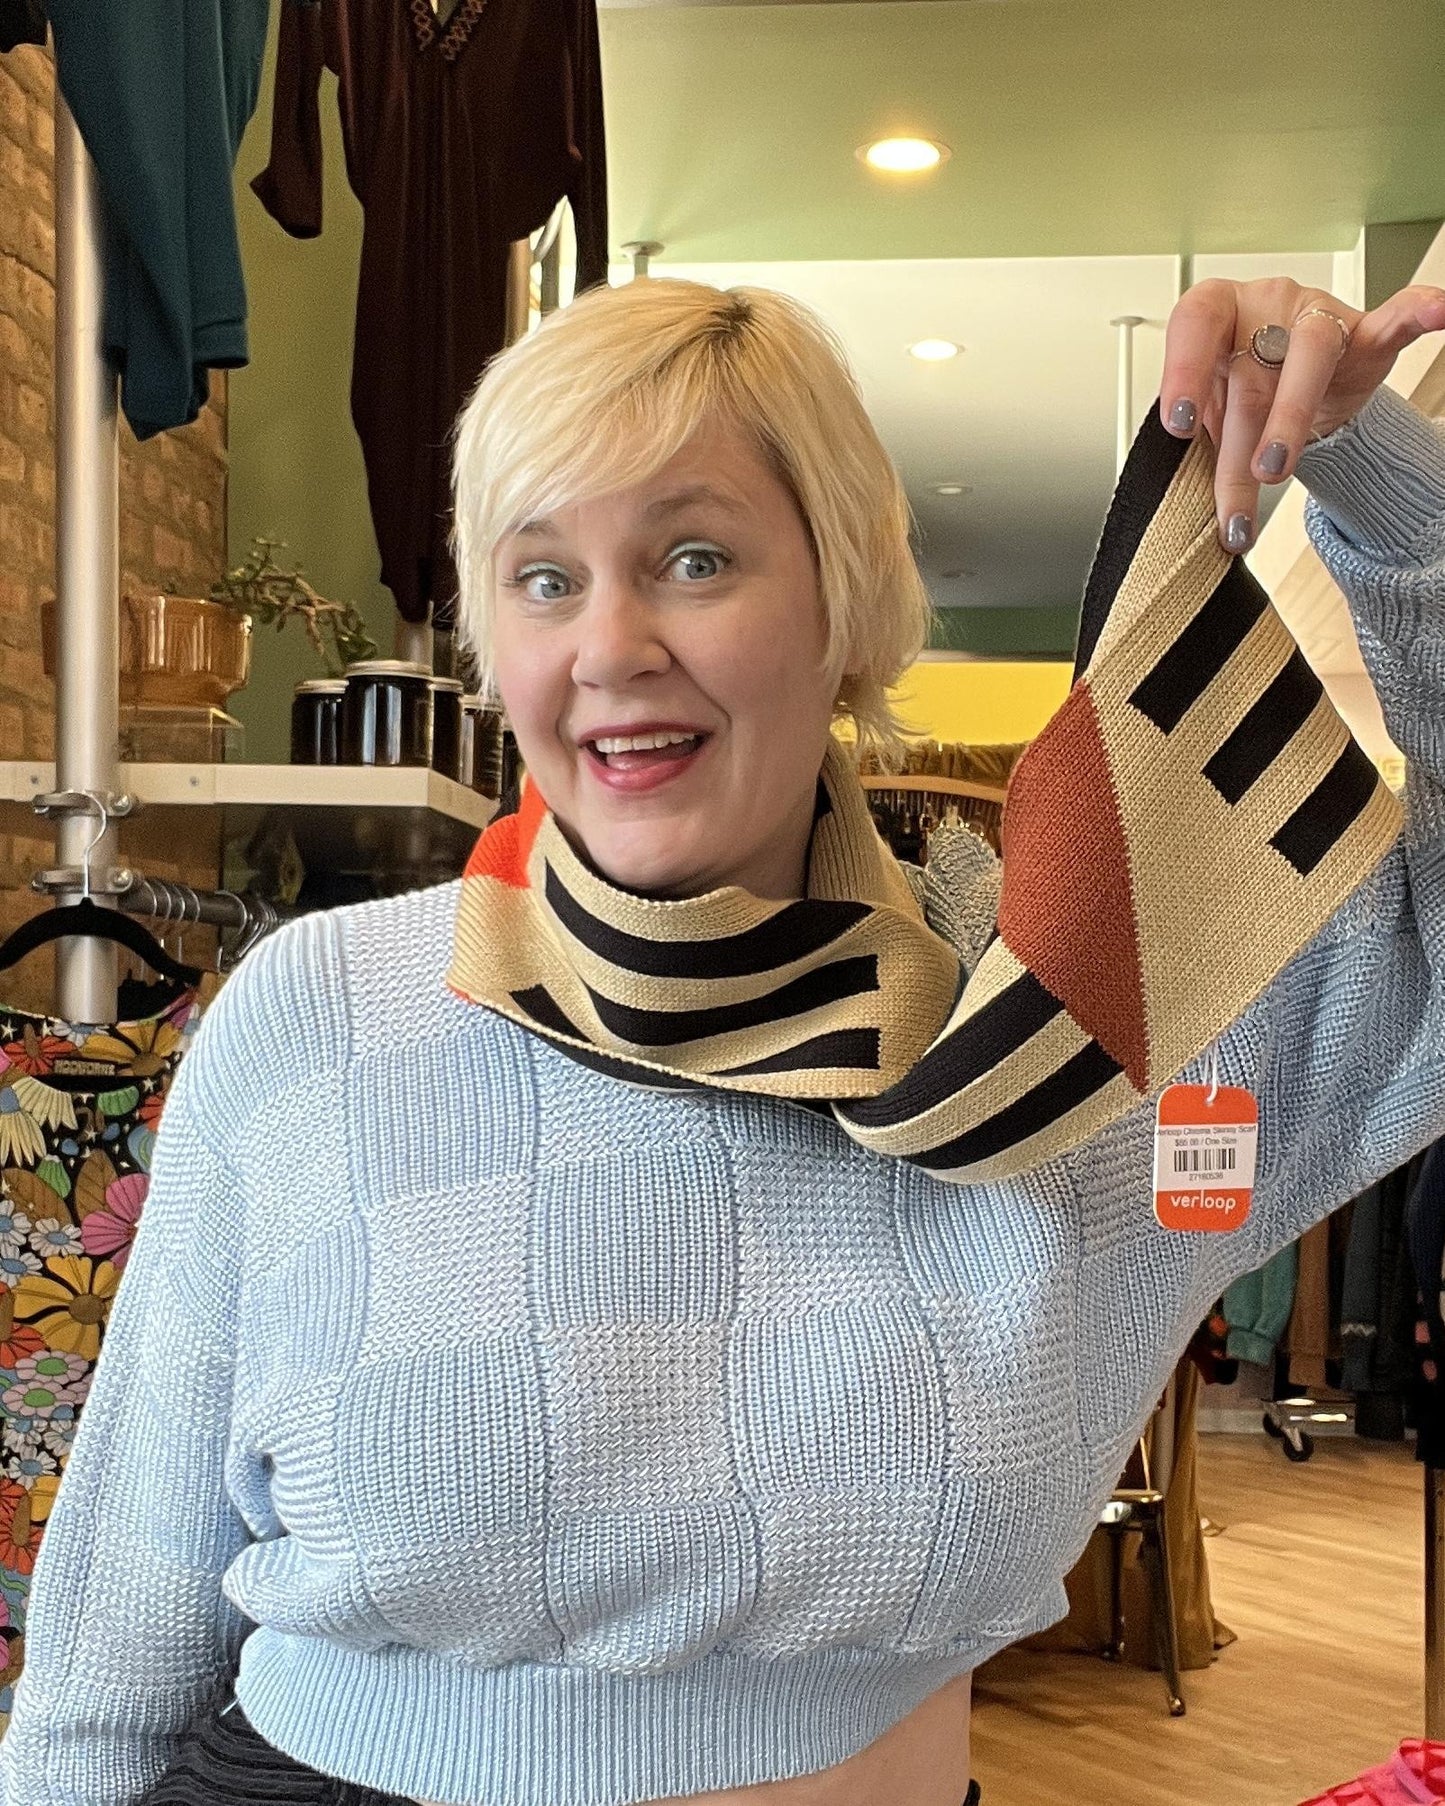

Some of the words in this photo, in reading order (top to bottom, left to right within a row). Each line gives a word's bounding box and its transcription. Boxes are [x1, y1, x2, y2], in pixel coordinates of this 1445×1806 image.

[1204, 1137, 1221, 1146] One
[1221, 1136, 1237, 1145] Size
[1170, 1190, 1236, 1215] verloop
